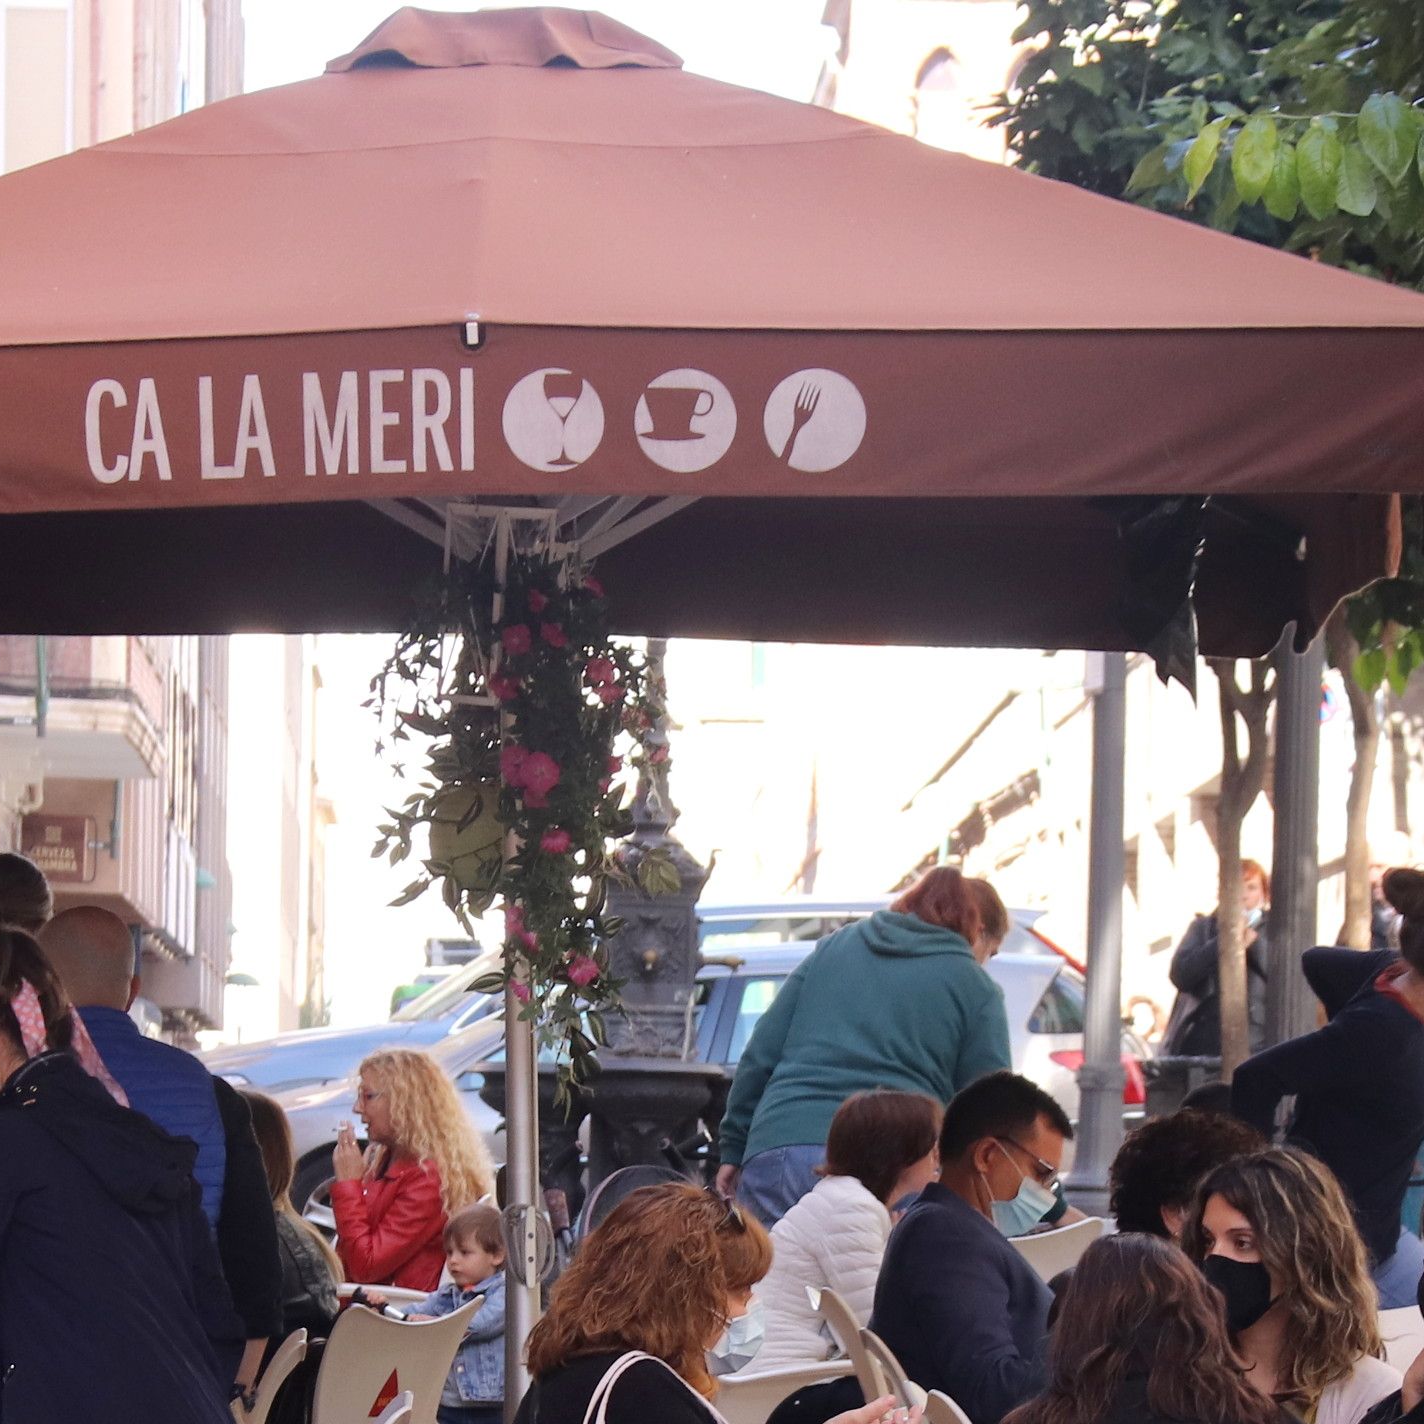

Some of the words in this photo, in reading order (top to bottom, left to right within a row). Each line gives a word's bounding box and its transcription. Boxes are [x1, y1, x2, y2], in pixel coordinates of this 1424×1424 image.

[84, 377, 173, 484] CA
[198, 374, 276, 480] LA
[302, 367, 475, 476] MERI
